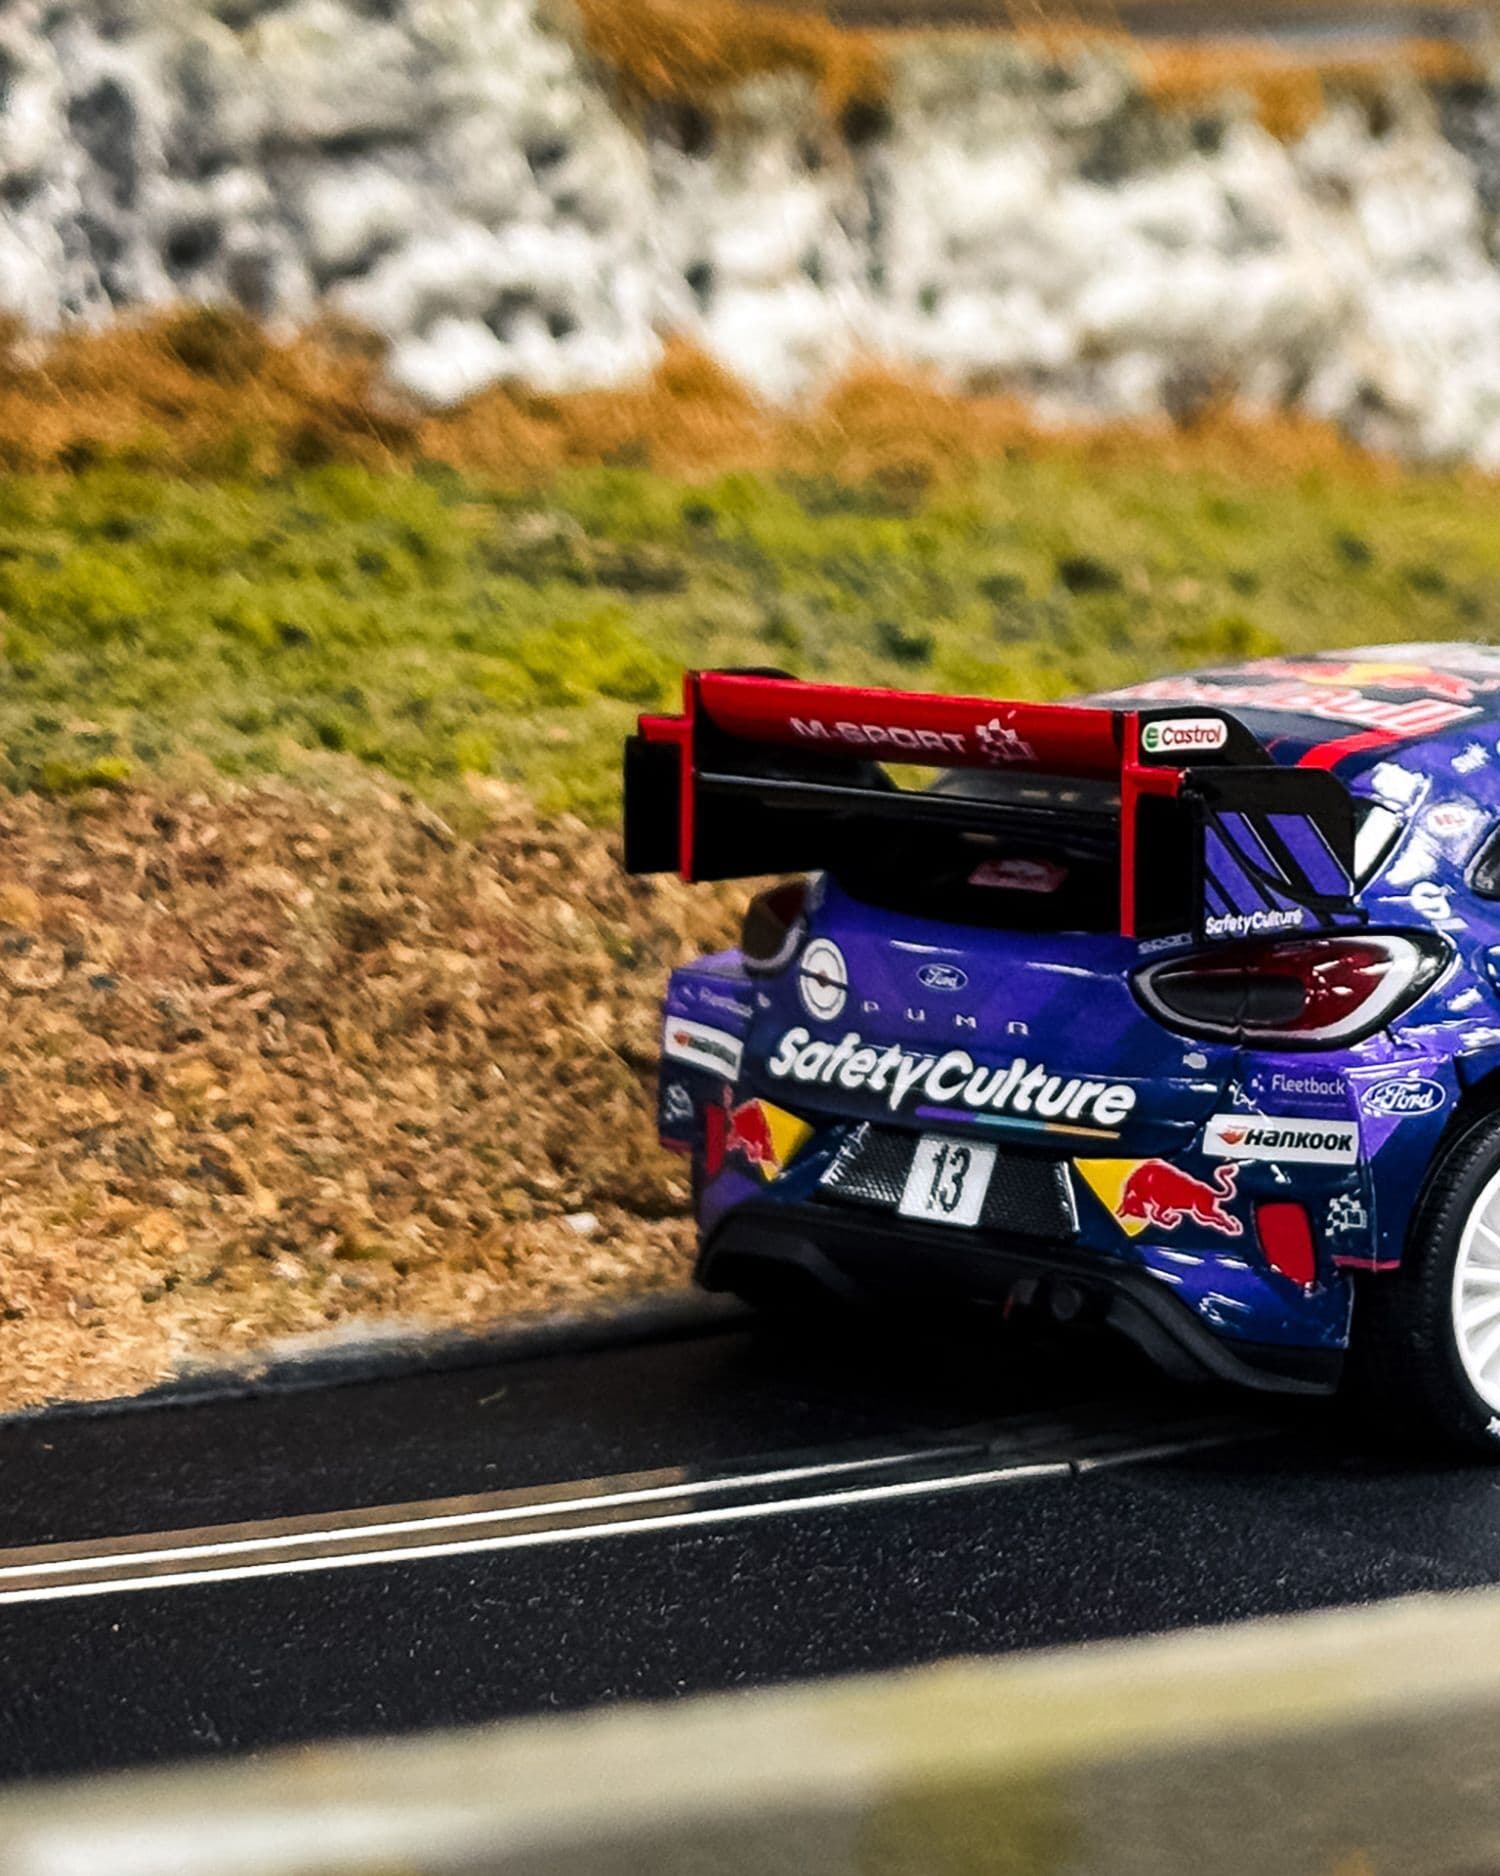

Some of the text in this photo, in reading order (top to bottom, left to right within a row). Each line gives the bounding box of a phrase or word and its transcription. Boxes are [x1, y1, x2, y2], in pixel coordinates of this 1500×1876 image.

[1161, 722, 1224, 747] Castrol
[1205, 908, 1303, 935] SafetyCulture
[925, 964, 959, 989] Ford
[769, 1026, 1137, 1125] SafetyCulture
[1271, 1074, 1346, 1095] Fleetback
[1372, 1081, 1436, 1111] Ford
[928, 1144, 970, 1214] 13
